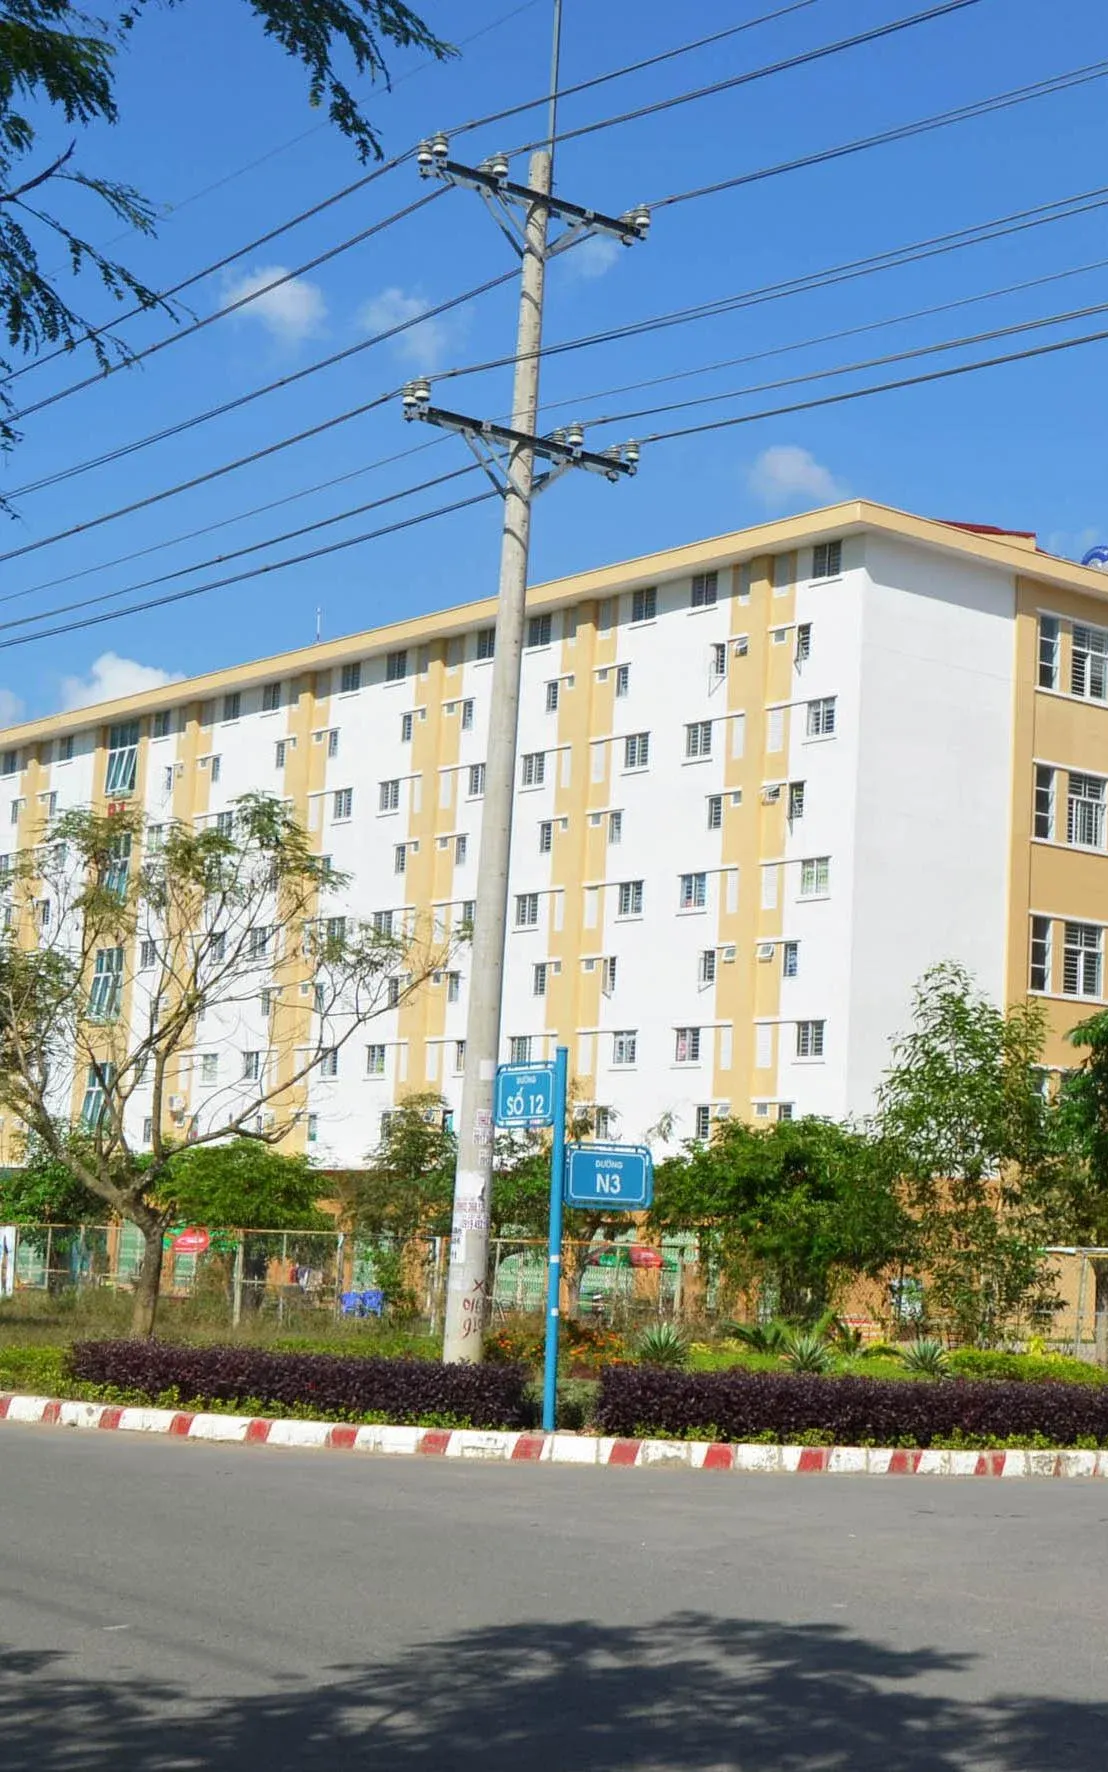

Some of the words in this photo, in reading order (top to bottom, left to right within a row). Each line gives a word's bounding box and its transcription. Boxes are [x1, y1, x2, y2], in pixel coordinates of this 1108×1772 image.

[506, 1086, 524, 1116] SỐ
[529, 1094, 545, 1115] 12
[596, 1173, 621, 1195] N3
